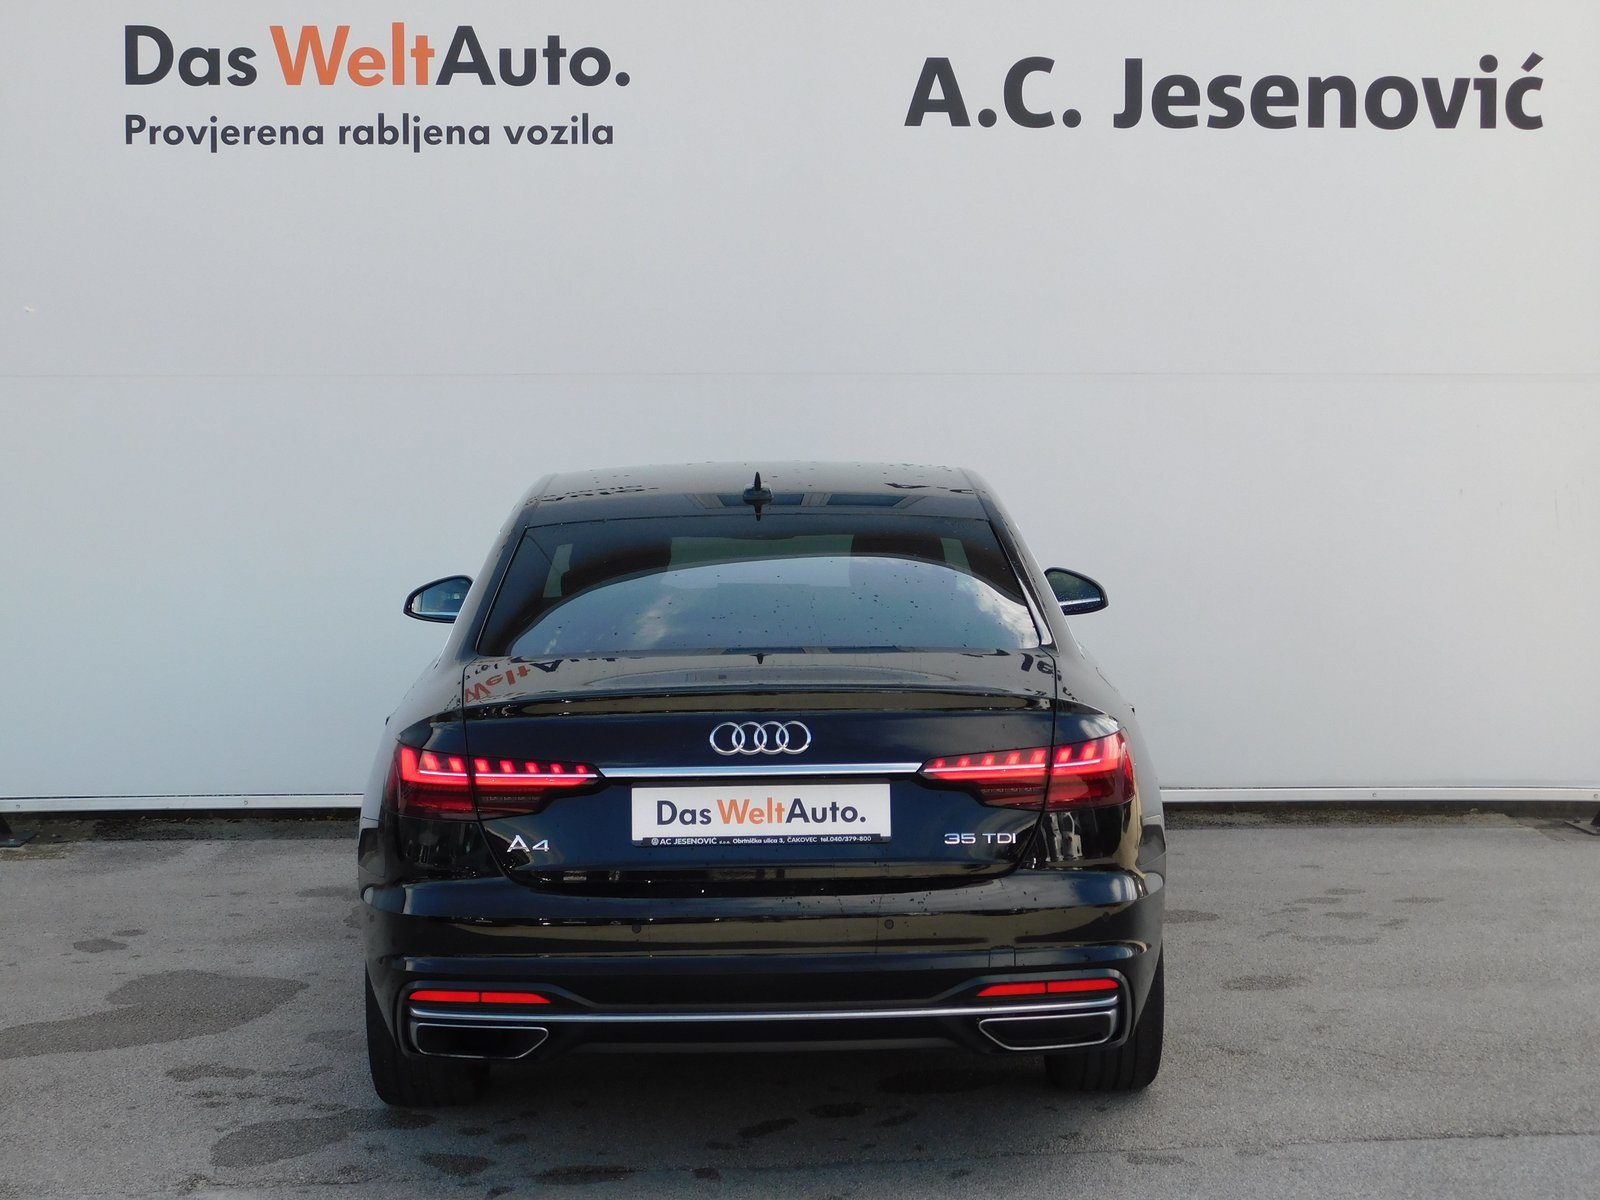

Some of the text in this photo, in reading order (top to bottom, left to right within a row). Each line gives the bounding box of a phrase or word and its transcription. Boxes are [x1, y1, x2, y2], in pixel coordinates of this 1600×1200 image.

[125, 22, 630, 87] Das WeltAuto.
[904, 52, 1544, 131] A.C. Jesenović
[126, 113, 613, 153] Provjerena rabljena vozila
[656, 797, 867, 826] Das WeltAuto.
[506, 834, 549, 853] A4
[673, 837, 717, 845] JESENOVIĆ
[944, 832, 1017, 845] 35 TDI
